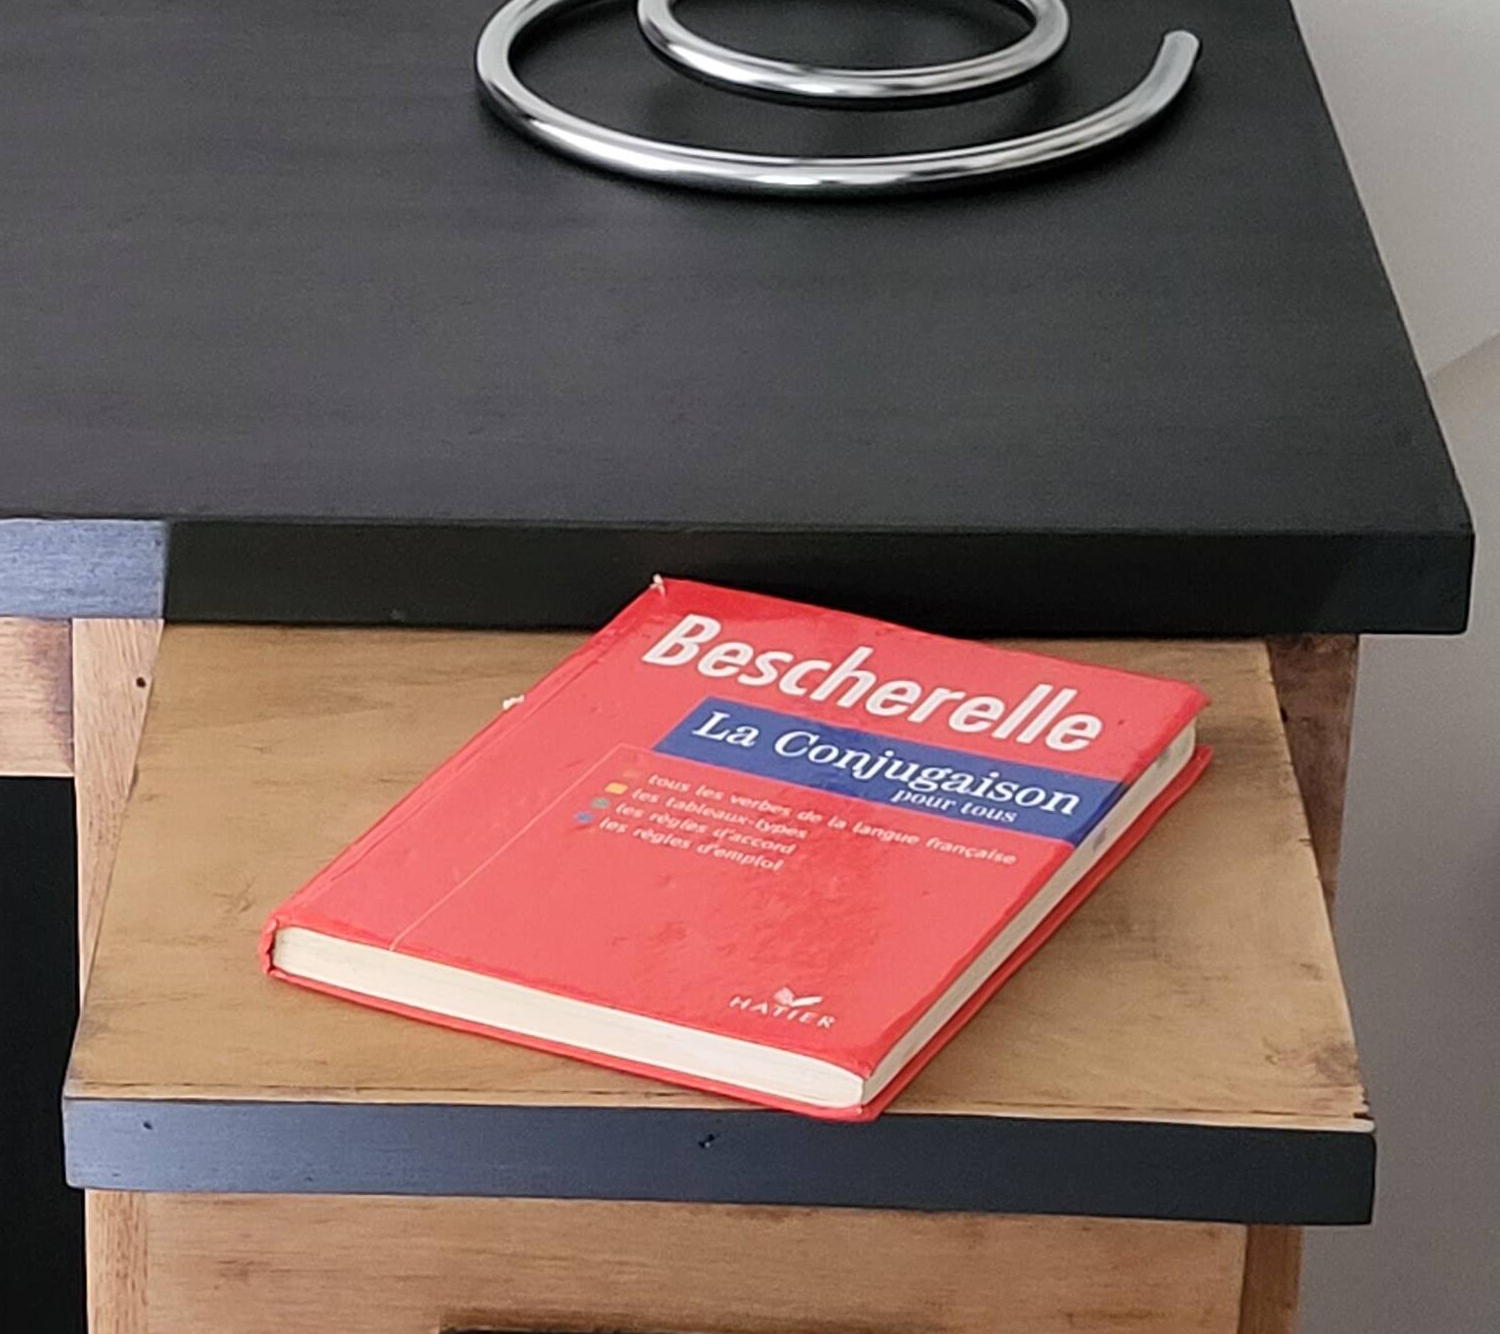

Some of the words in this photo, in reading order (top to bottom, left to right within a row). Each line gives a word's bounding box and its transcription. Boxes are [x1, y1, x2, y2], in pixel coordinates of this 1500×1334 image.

[641, 613, 1103, 753] Bescherelle
[692, 710, 757, 747] La
[774, 730, 1082, 816] Conjugaison
[615, 802, 645, 820] les
[649, 812, 709, 836] règles
[712, 827, 798, 856] d'accord
[631, 788, 660, 805] les
[664, 796, 809, 840] tableaux-types
[648, 773, 691, 793] tous
[695, 784, 725, 802] les
[729, 793, 793, 818] verbes
[797, 810, 824, 824] de
[827, 816, 848, 831] la
[852, 821, 920, 846] langue
[924, 836, 1018, 866] française
[890, 789, 957, 812] pour
[961, 801, 1018, 824] tous
[599, 817, 629, 835] les
[632, 827, 693, 851] règles
[728, 995, 836, 1029] HATIER
